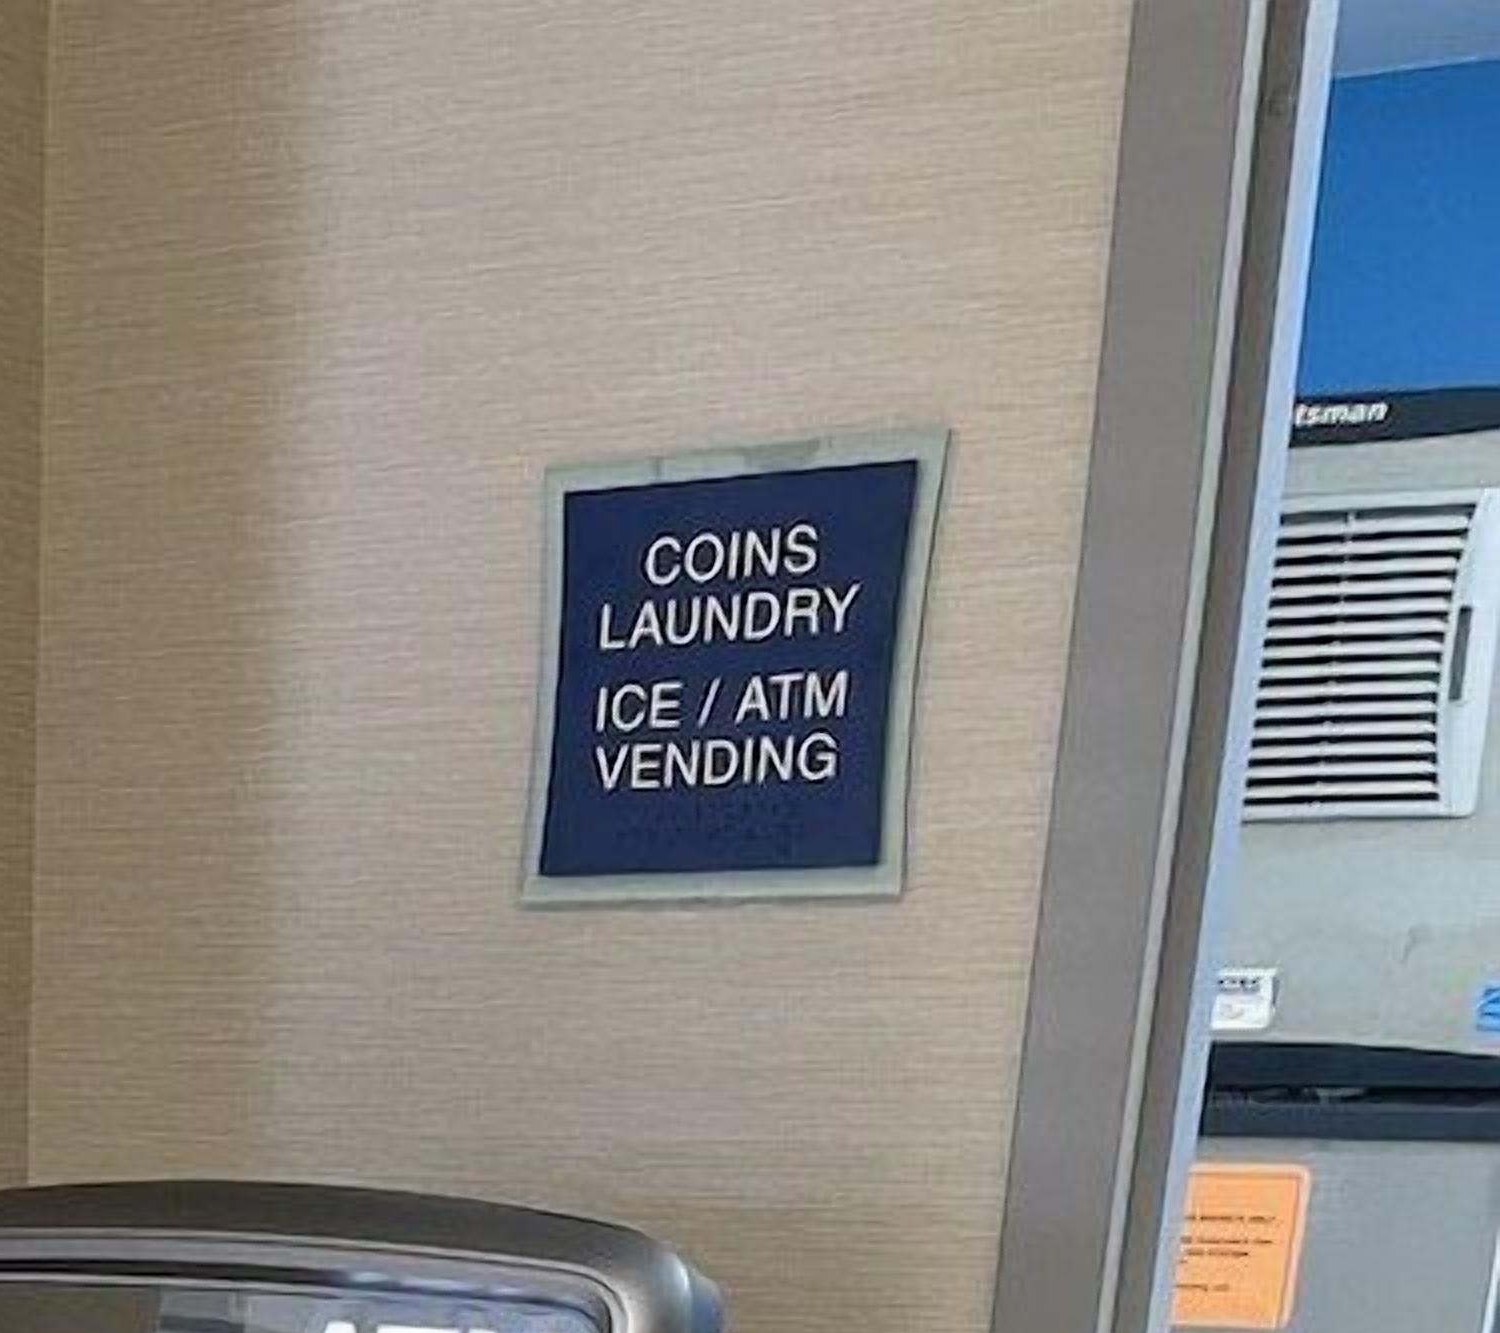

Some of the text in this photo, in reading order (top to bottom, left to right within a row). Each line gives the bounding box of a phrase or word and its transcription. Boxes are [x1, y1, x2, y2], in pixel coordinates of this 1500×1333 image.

[1296, 402, 1389, 427] tsman
[645, 524, 818, 586] COINS
[600, 583, 862, 650] LAUNDRY
[596, 670, 849, 733] ICE / ATM
[596, 732, 838, 792] VENDING
